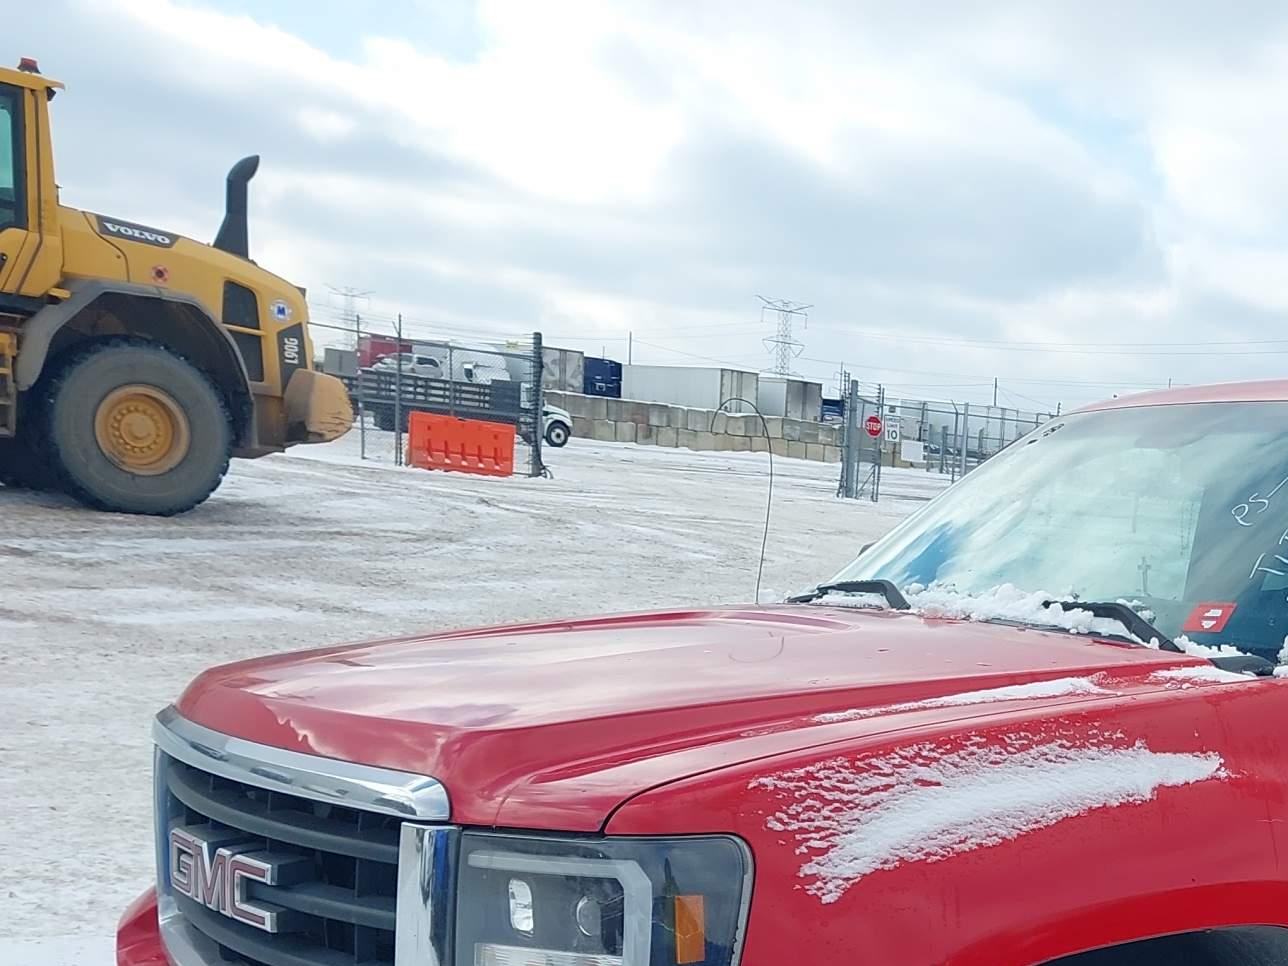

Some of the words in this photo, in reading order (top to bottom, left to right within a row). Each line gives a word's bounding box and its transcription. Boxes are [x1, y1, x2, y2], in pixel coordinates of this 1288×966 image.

[103, 221, 171, 245] VOLVO
[283, 337, 299, 365] L90G
[864, 420, 881, 431] STOP
[887, 429, 898, 440] 10
[169, 827, 277, 934] GMC
